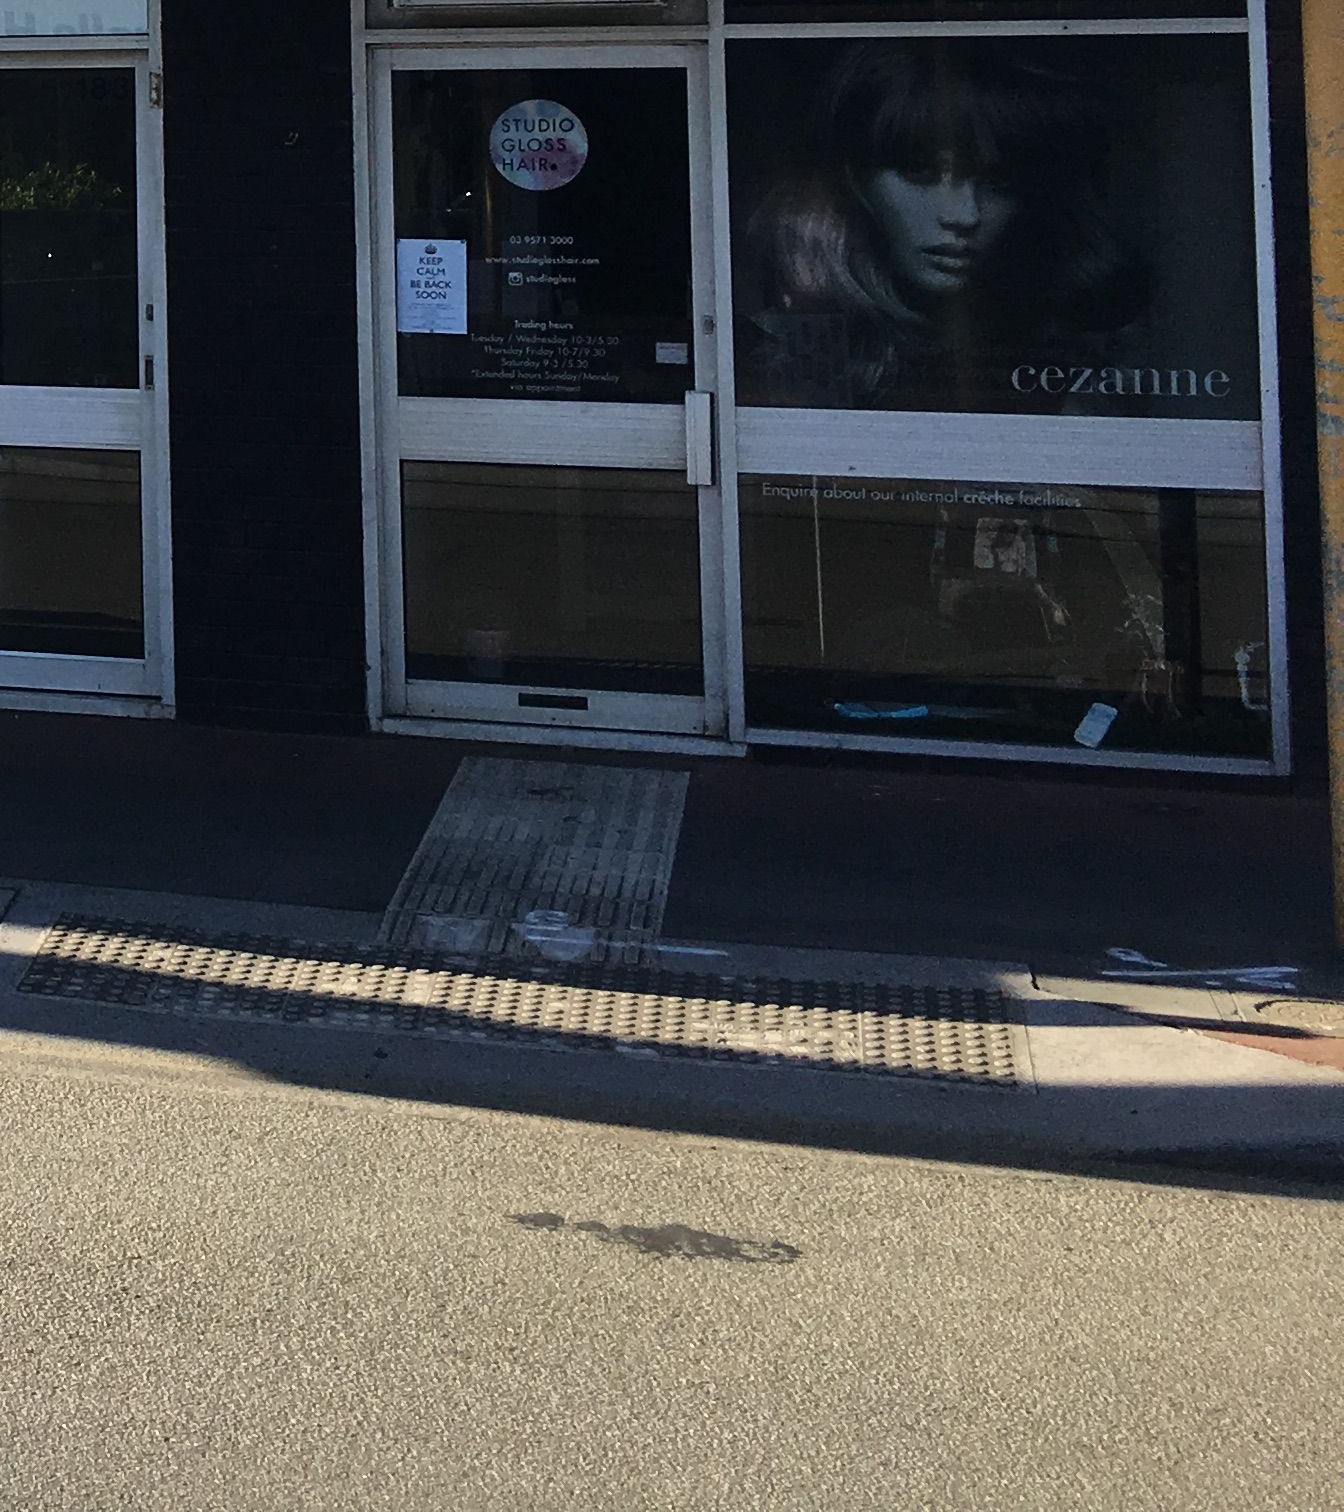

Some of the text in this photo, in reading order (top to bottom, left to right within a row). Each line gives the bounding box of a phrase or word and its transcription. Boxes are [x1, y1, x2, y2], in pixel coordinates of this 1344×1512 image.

[501, 118, 574, 133] STUDIO
[501, 138, 566, 153] GLOSS
[419, 257, 443, 265] KEEP
[416, 267, 446, 276] CALM
[410, 280, 452, 289] BE BACK
[415, 290, 447, 300] SOON
[1011, 361, 1231, 398] cezanne
[823, 484, 866, 500] about
[871, 491, 894, 501] our
[900, 489, 959, 503] internal
